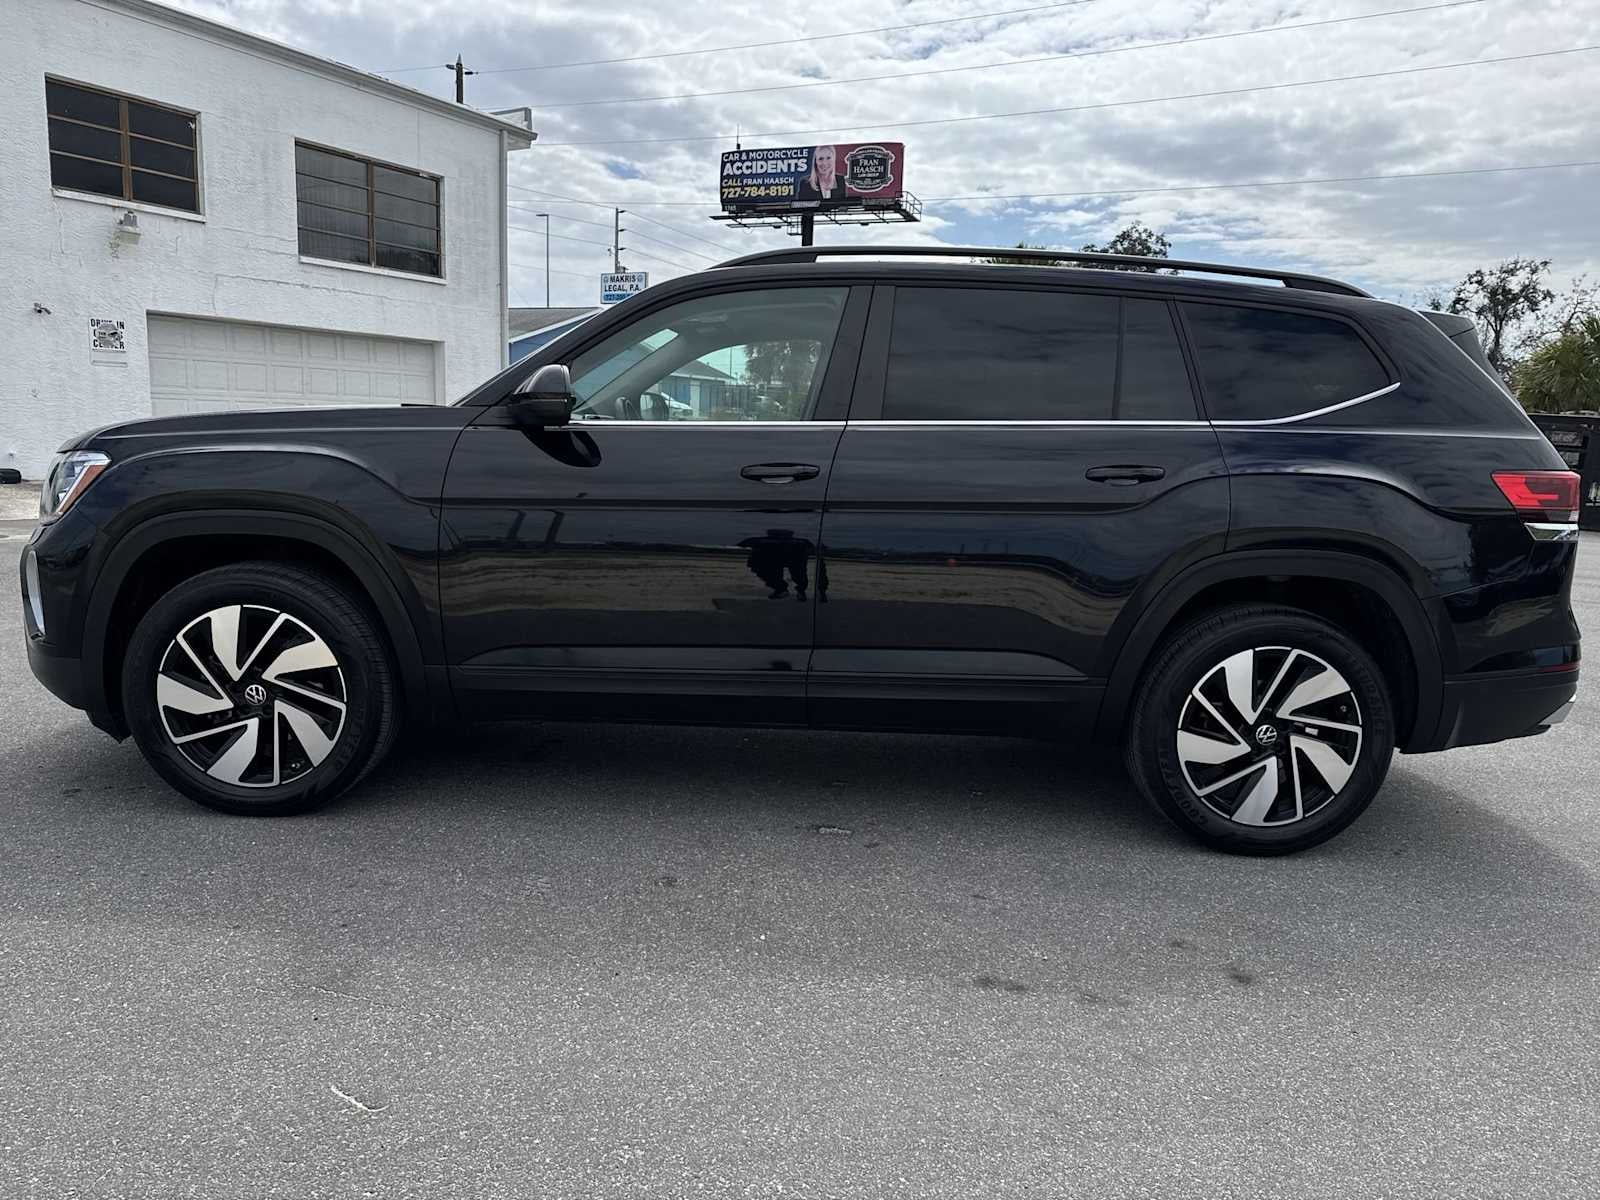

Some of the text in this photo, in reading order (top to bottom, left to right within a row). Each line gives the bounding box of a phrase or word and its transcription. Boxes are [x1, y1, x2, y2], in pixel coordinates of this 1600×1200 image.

[723, 152, 739, 161] CAR
[749, 149, 808, 160] MOTORCYCLE
[723, 159, 808, 176] ACCIDENTS
[764, 176, 794, 184] HAASCH
[722, 185, 794, 199] 727-784-8191
[610, 275, 636, 283] MAKRIS
